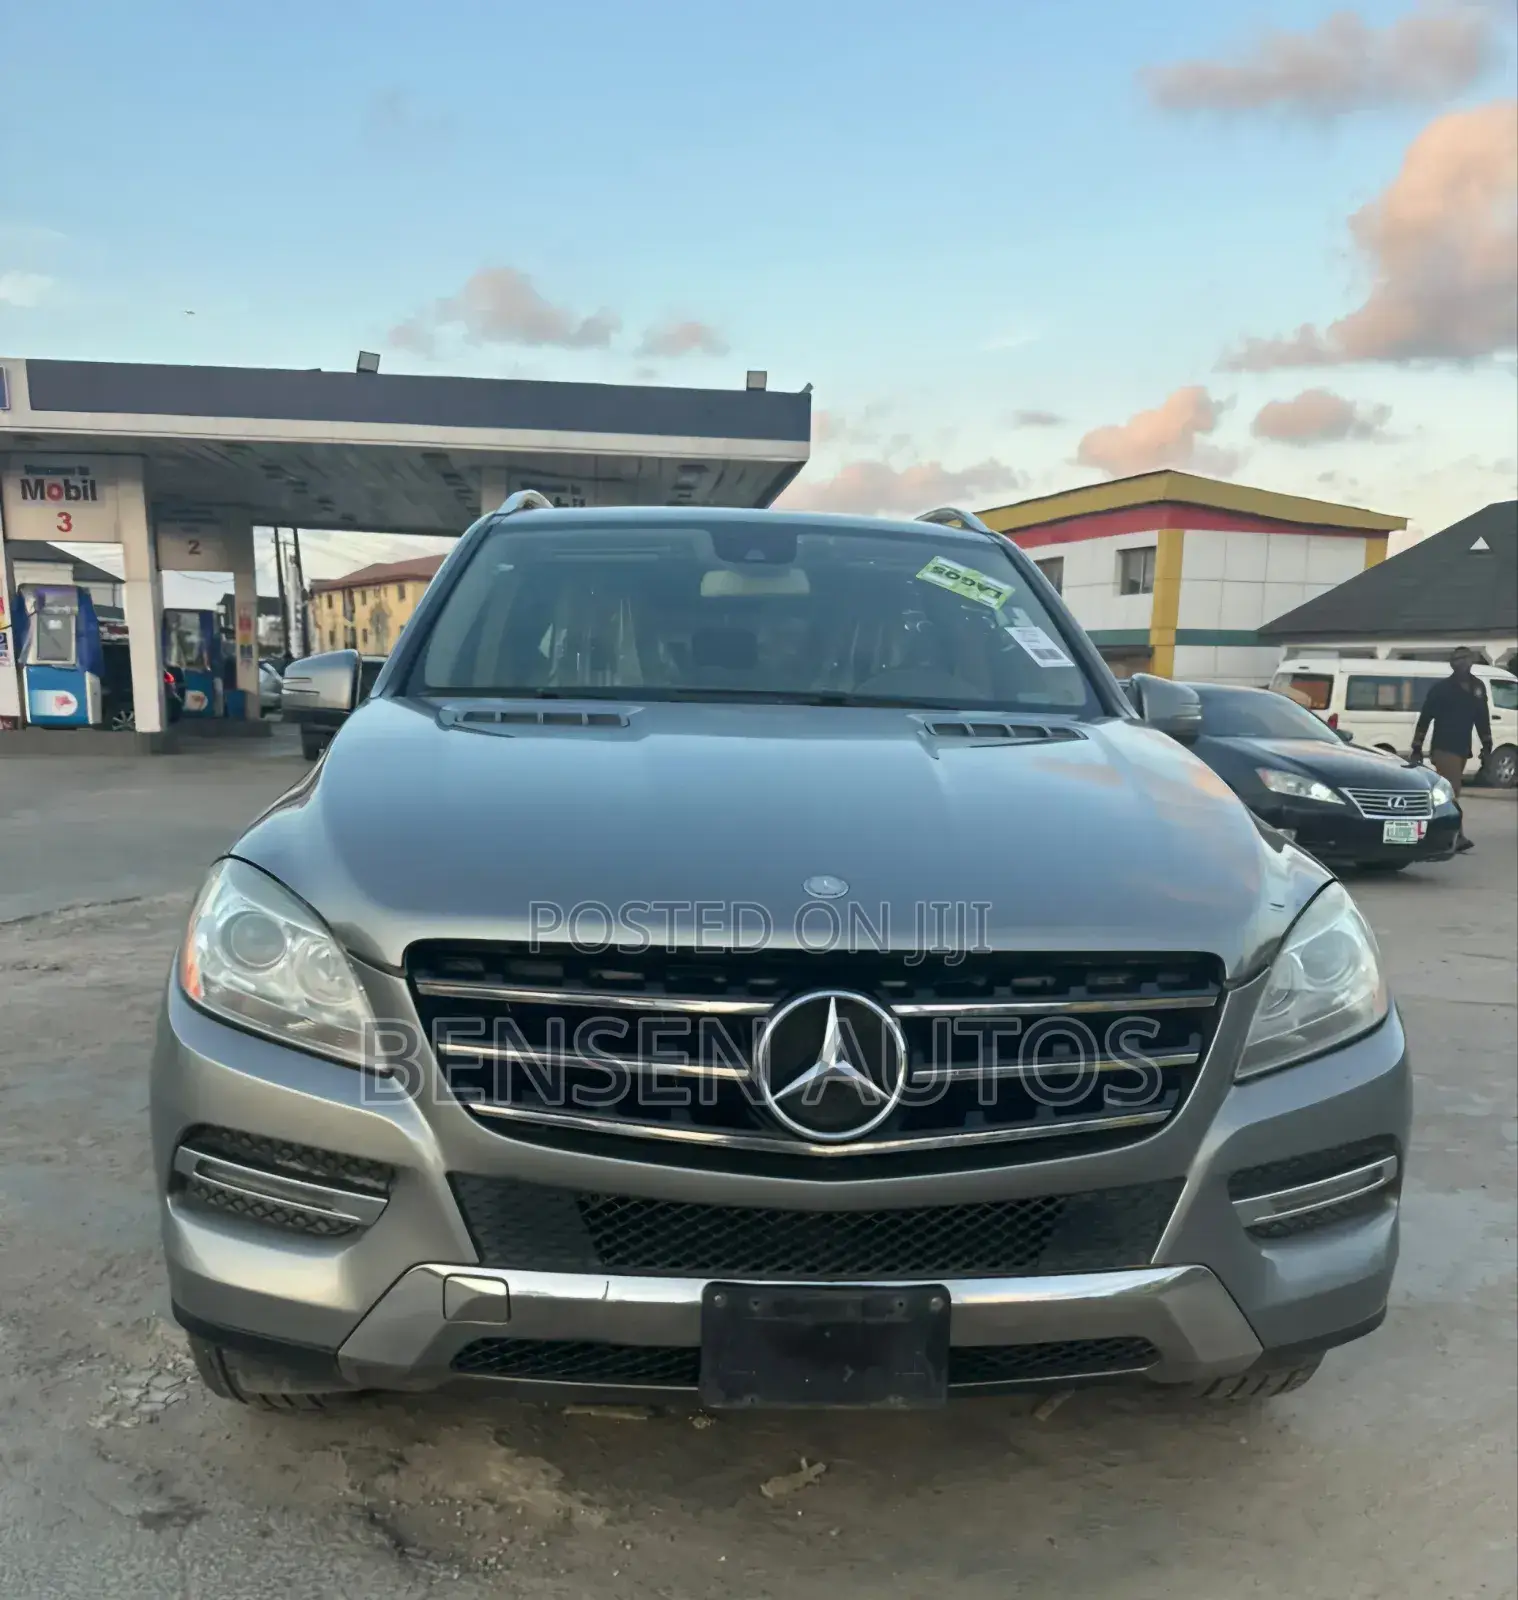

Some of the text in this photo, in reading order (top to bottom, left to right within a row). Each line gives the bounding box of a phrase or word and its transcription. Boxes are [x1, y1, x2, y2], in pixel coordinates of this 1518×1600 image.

[20, 479, 98, 501] Mobil
[57, 511, 73, 532] 3
[188, 540, 201, 555] 2
